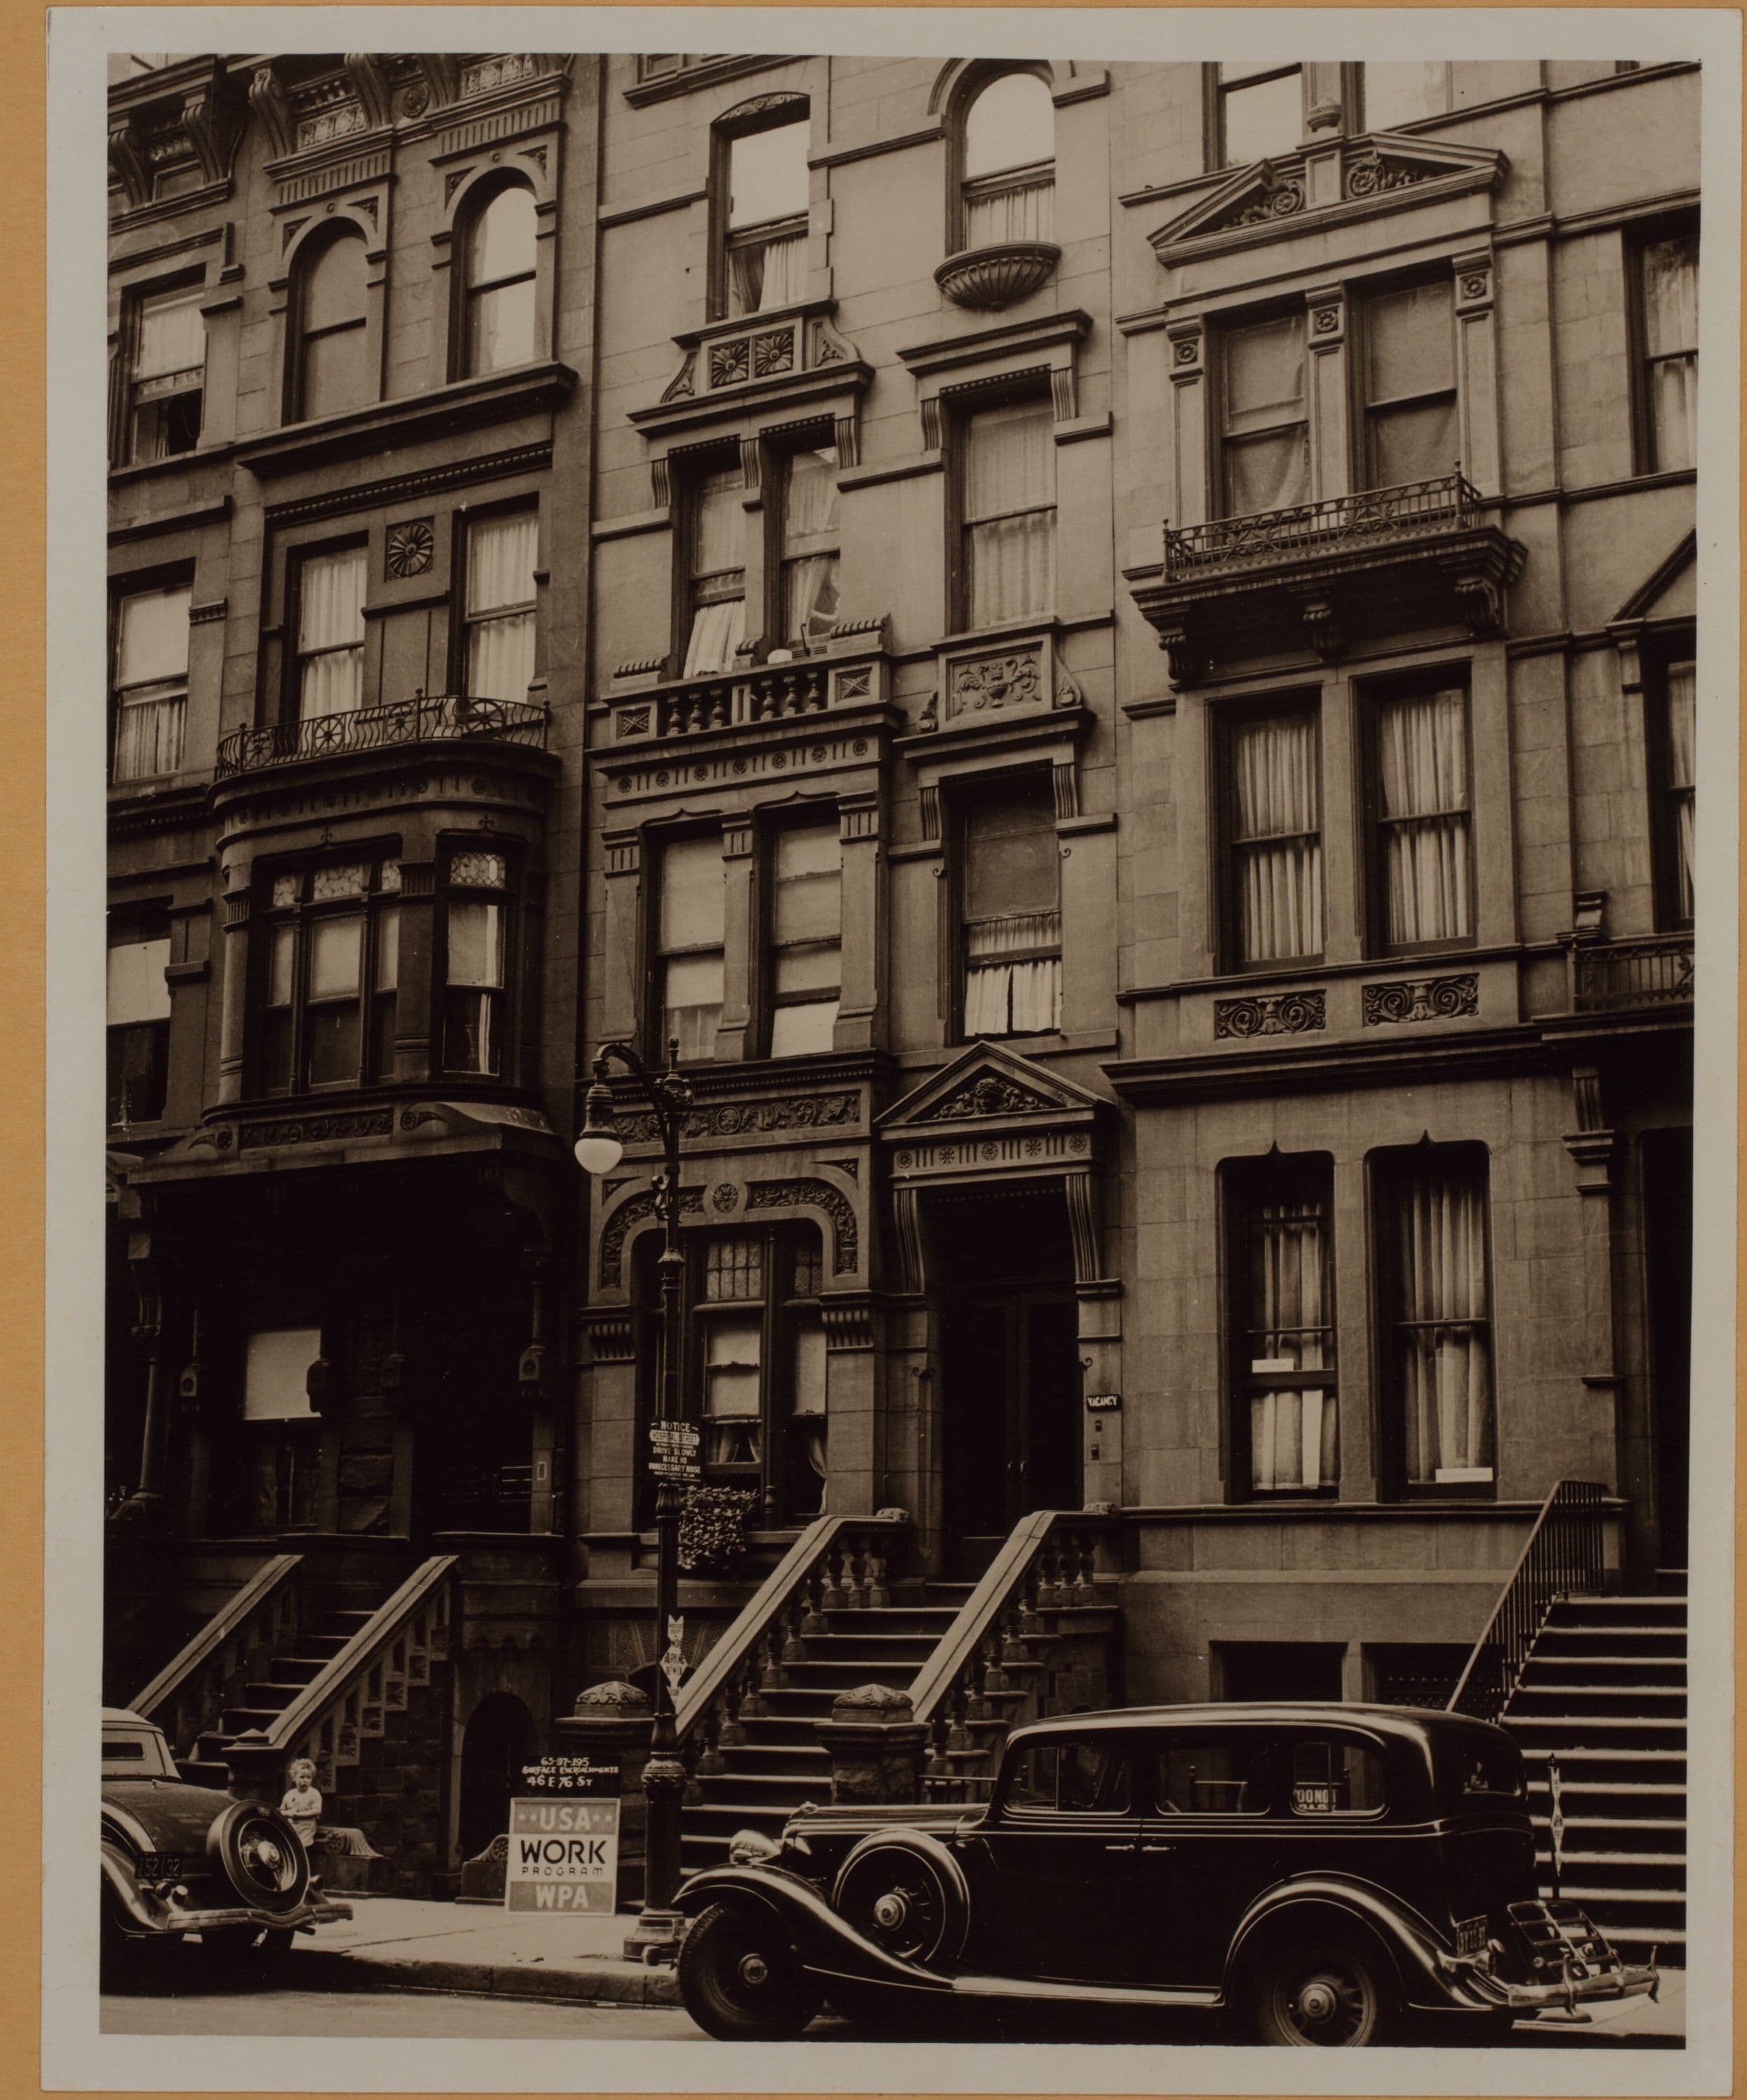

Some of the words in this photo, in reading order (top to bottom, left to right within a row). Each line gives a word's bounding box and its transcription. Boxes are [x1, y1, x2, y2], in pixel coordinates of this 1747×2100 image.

[1087, 1395, 1117, 1407] VACANCY
[660, 1421, 691, 1432] NOTICE
[653, 1431, 677, 1442] HOSPITAL
[679, 1434, 698, 1444] STREET
[653, 1446, 671, 1455] DRIVE
[673, 1449, 697, 1457] SLOWLY
[527, 1775, 546, 1786] 46
[549, 1777, 556, 1787] E
[558, 1776, 574, 1789] 76
[539, 1807, 591, 1831] USA
[521, 1840, 607, 1864] WORK
[522, 1866, 603, 1876] PROGRAM
[535, 1884, 589, 1909] WPA
